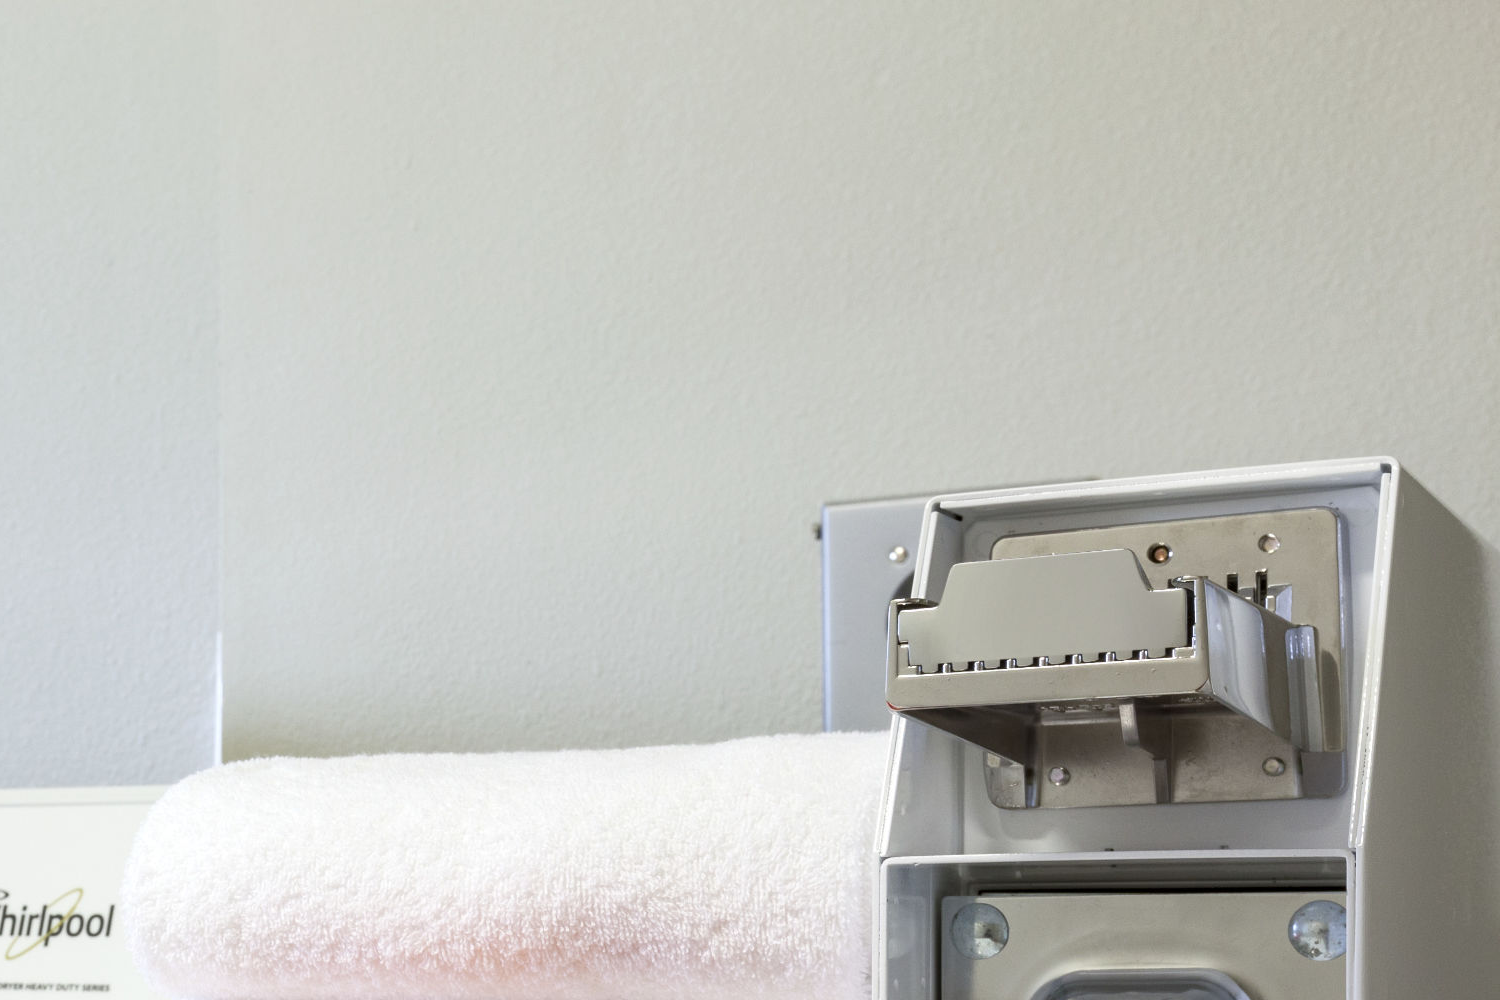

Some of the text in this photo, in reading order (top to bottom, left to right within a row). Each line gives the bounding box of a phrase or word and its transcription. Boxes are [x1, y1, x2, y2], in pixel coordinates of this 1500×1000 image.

[25, 982, 54, 992] HEAVY
[56, 983, 79, 992] DUTY
[82, 983, 111, 992] SERIES
